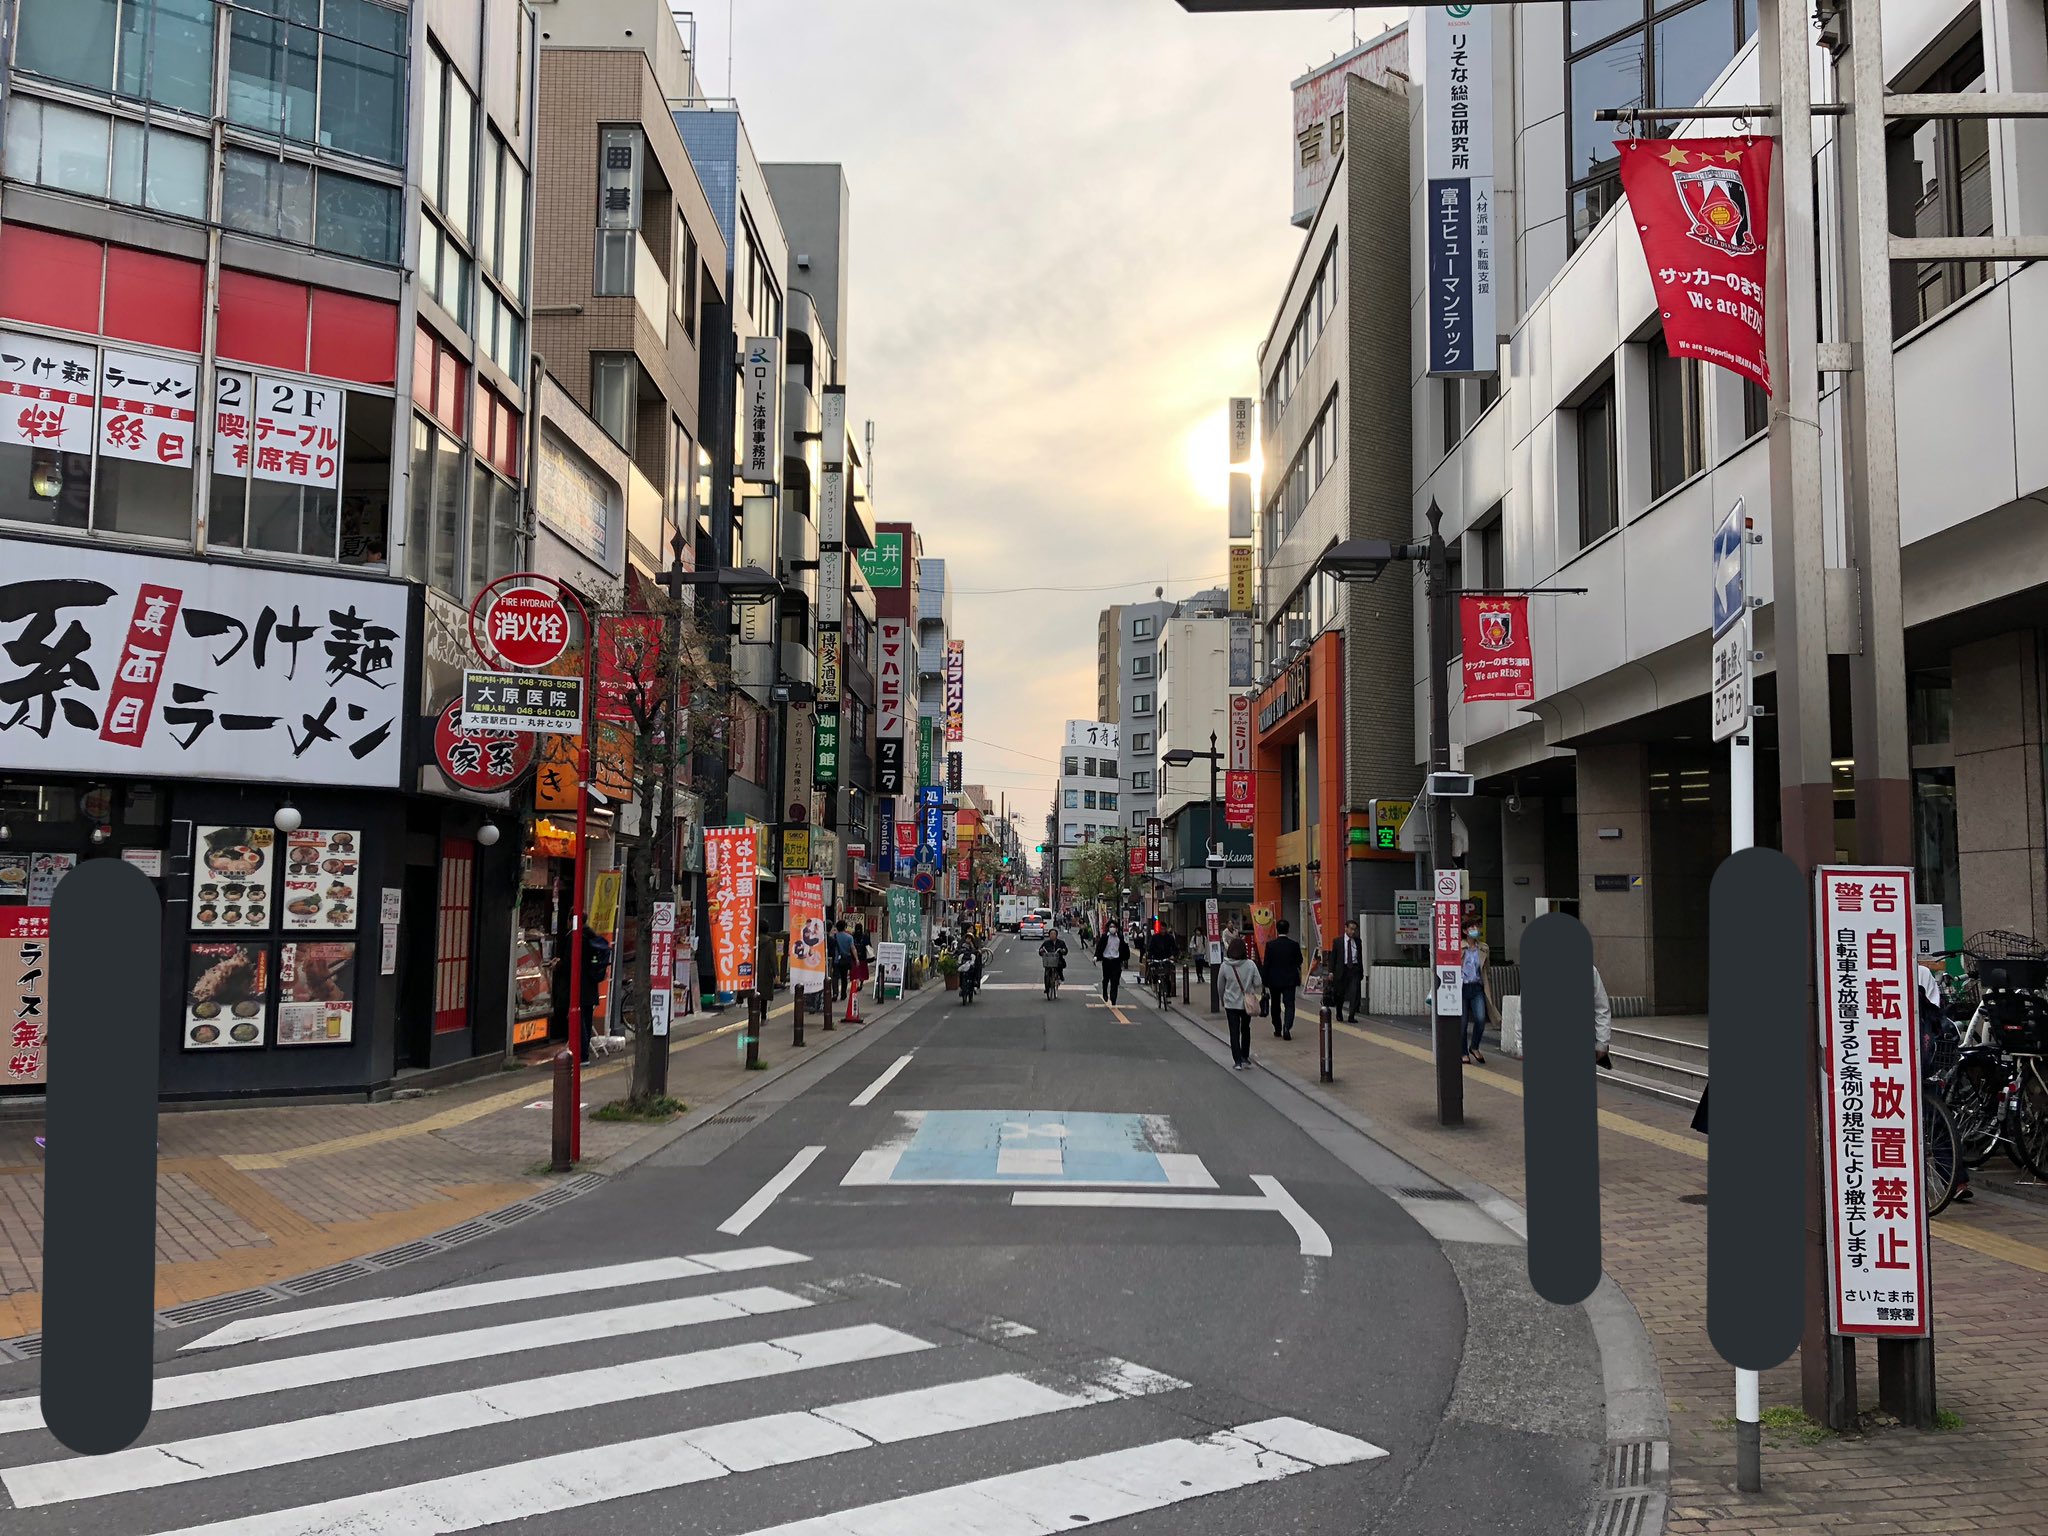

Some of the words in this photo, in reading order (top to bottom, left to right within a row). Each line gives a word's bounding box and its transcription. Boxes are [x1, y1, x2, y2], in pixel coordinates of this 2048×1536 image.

[1451, 34, 1469, 170] りそな総合研究所
[1477, 191, 1489, 294] 人材派遣・転職支援
[1441, 188, 1460, 365] 富士ヒューマンテック
[1688, 291, 1713, 310] We
[1717, 297, 1738, 317] are
[1740, 302, 1762, 337] REDS
[1679, 340, 1690, 349] We
[1692, 342, 1703, 351] are
[1704, 345, 1735, 363] supporting
[2, 354, 91, 386] つけ麺
[106, 367, 192, 399] ラーメン
[11, 383, 79, 404] 真面目
[116, 399, 180, 419] 真面目
[273, 386, 326, 417] 2F
[17, 404, 69, 447] 料
[256, 418, 338, 450] テーブル
[752, 367, 766, 470] ロード法律事務所
[106, 415, 184, 463] 終日
[257, 448, 335, 479] 席有り
[861, 544, 899, 562] 石井
[861, 565, 899, 577] クリニック
[501, 597, 518, 607] FIRE
[520, 598, 555, 609] HYDRANT
[495, 612, 562, 643] 消火栓
[745, 606, 755, 640] VIVID
[182, 605, 400, 690] つけ麺
[110, 595, 178, 733] 真面目
[821, 633, 837, 696] 博多酒場
[882, 625, 899, 731] ヤマハピアノ
[1465, 658, 1530, 671] サッカーのまち浦和
[1474, 672, 1485, 681] We
[1487, 671, 1499, 679] are
[1500, 668, 1521, 678] REDS!
[478, 687, 567, 708] 大原医院
[518, 679, 577, 689] 048-783-5298
[948, 653, 962, 711] カラオケ
[473, 703, 506, 713] 産婦人科
[517, 707, 576, 718] 048-641-0470
[1716, 684, 1742, 725] ここから
[163, 683, 396, 759] ラーメン
[471, 715, 573, 729] 大宮駅西口・丸井となり
[948, 729, 962, 739] 5F
[819, 715, 836, 766] 珈琲館
[447, 740, 519, 776] 家系
[882, 744, 896, 789] タニタ
[881, 814, 890, 855] Leonidas
[1378, 828, 1394, 846] 空
[787, 857, 804, 866] 受付
[1835, 882, 1898, 913] 警告
[8, 941, 44, 1079] ライス無料
[1836, 928, 1869, 1273] 自転車を放置すると条例の規定により撤去します。
[1865, 929, 1910, 1270] 自転車放置禁止
[1845, 1289, 1915, 1303] さいたま市
[1877, 1307, 1915, 1321] 警察署
